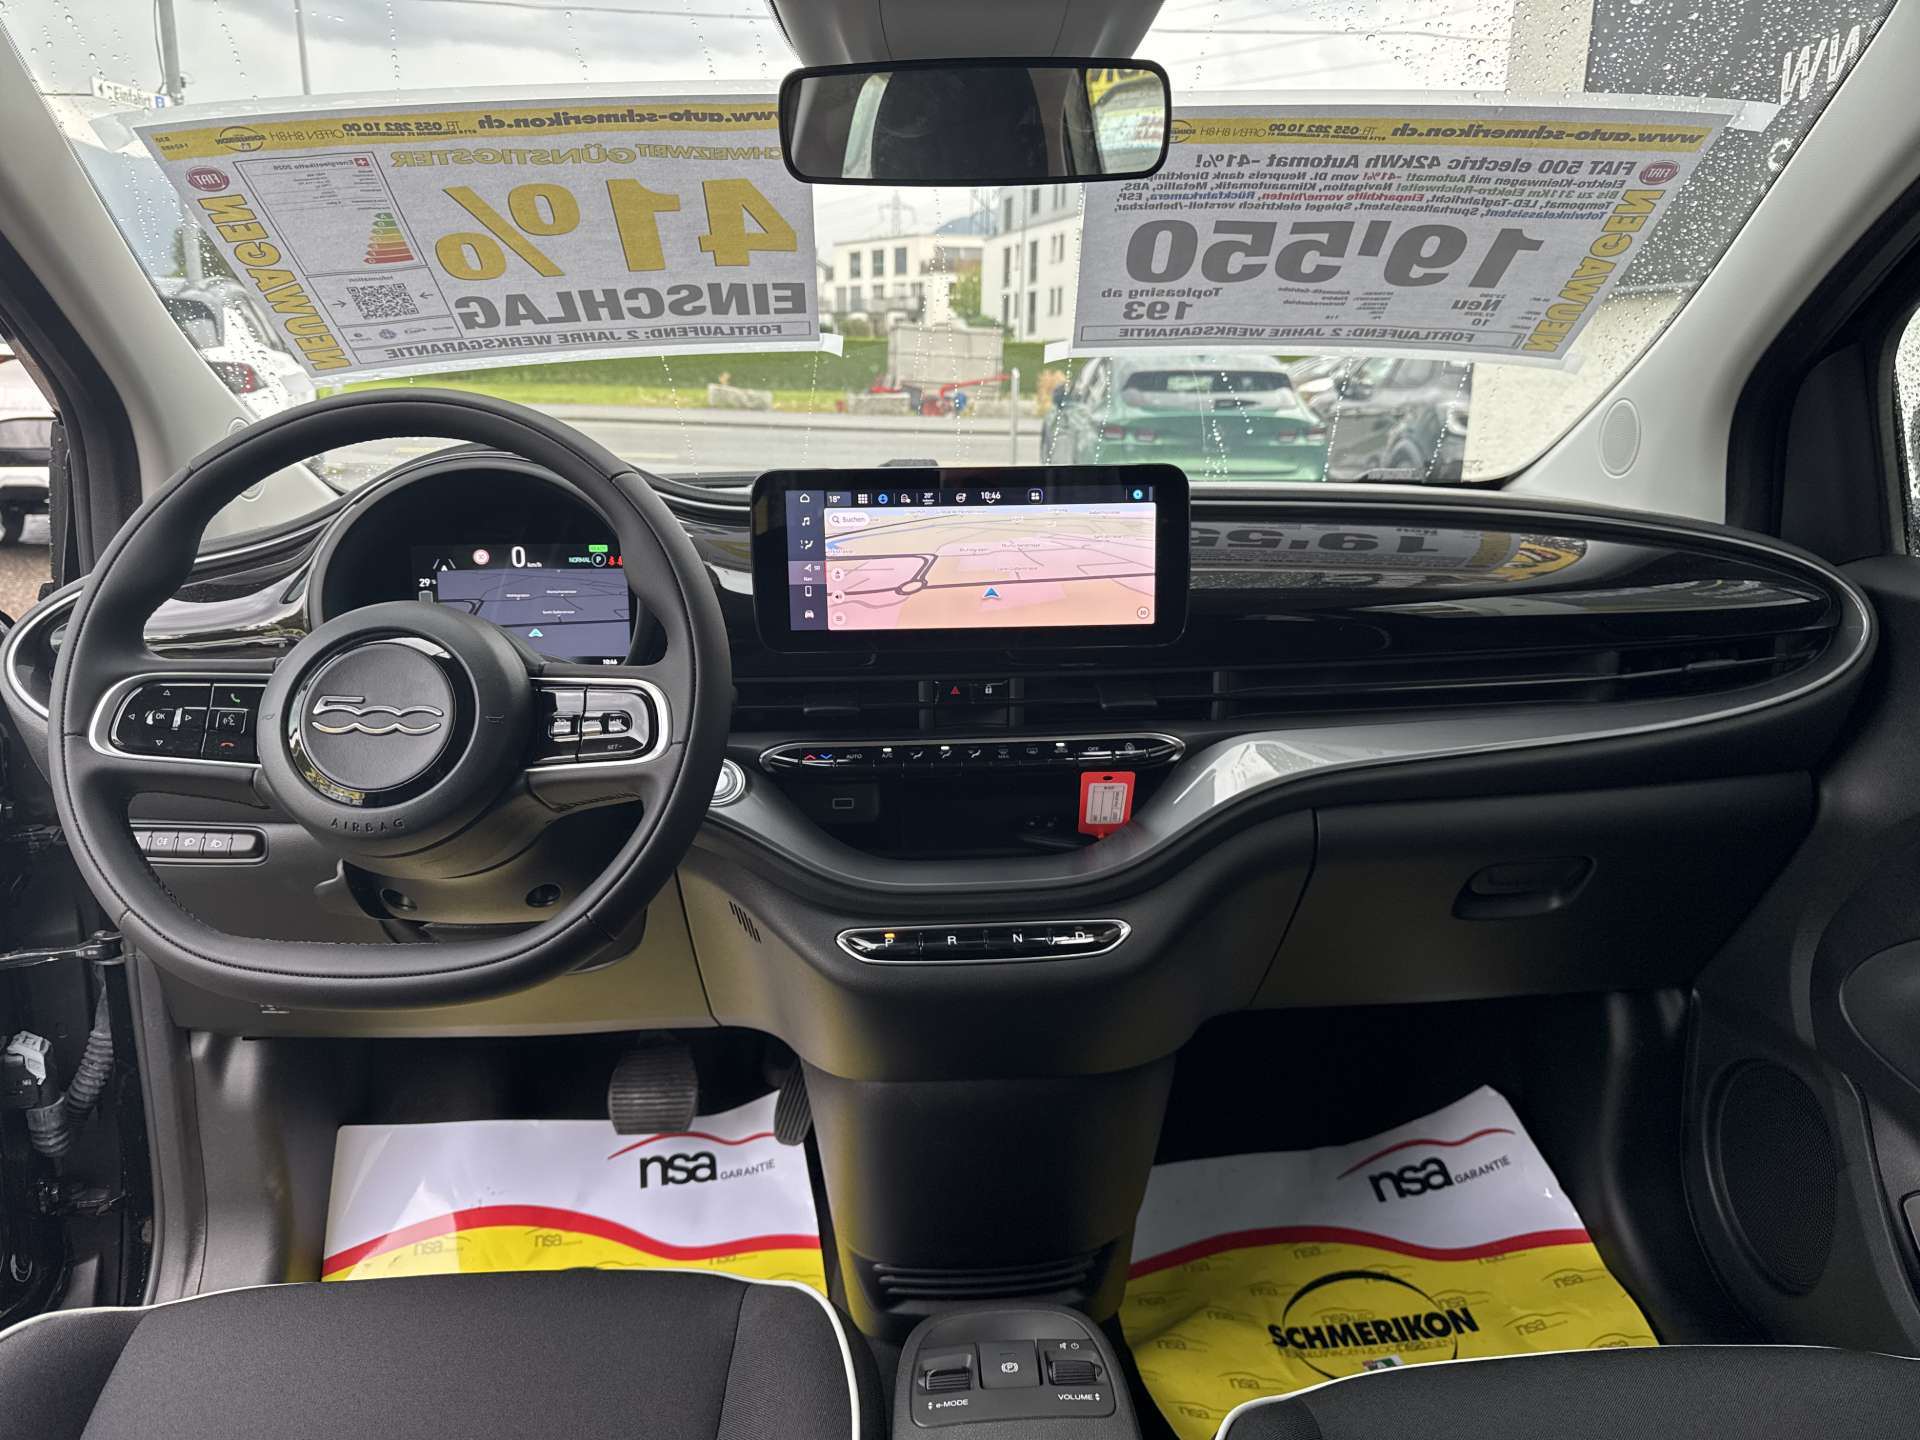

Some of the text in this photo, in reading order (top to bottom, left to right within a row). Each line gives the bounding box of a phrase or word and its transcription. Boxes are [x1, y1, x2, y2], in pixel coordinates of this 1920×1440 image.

[981, 491, 1001, 500] 10:46
[511, 545, 526, 568] 0
[418, 578, 431, 587] 29
[155, 711, 166, 720] OK
[330, 818, 405, 833] AIRBAG
[947, 935, 957, 945] R
[1013, 933, 1023, 944] N
[638, 1150, 776, 1189] nsa GARANTIE
[1368, 1154, 1512, 1203] nsa GARANTIE
[534, 1232, 562, 1248] nsa
[1553, 1275, 1584, 1288] nsa
[1268, 1307, 1480, 1350] SCHMERIKON
[1515, 1318, 1546, 1336] nsa
[1230, 1377, 1260, 1391] nsa
[936, 1399, 969, 1409] e-MODE
[1058, 1393, 1093, 1401] VOLUME
